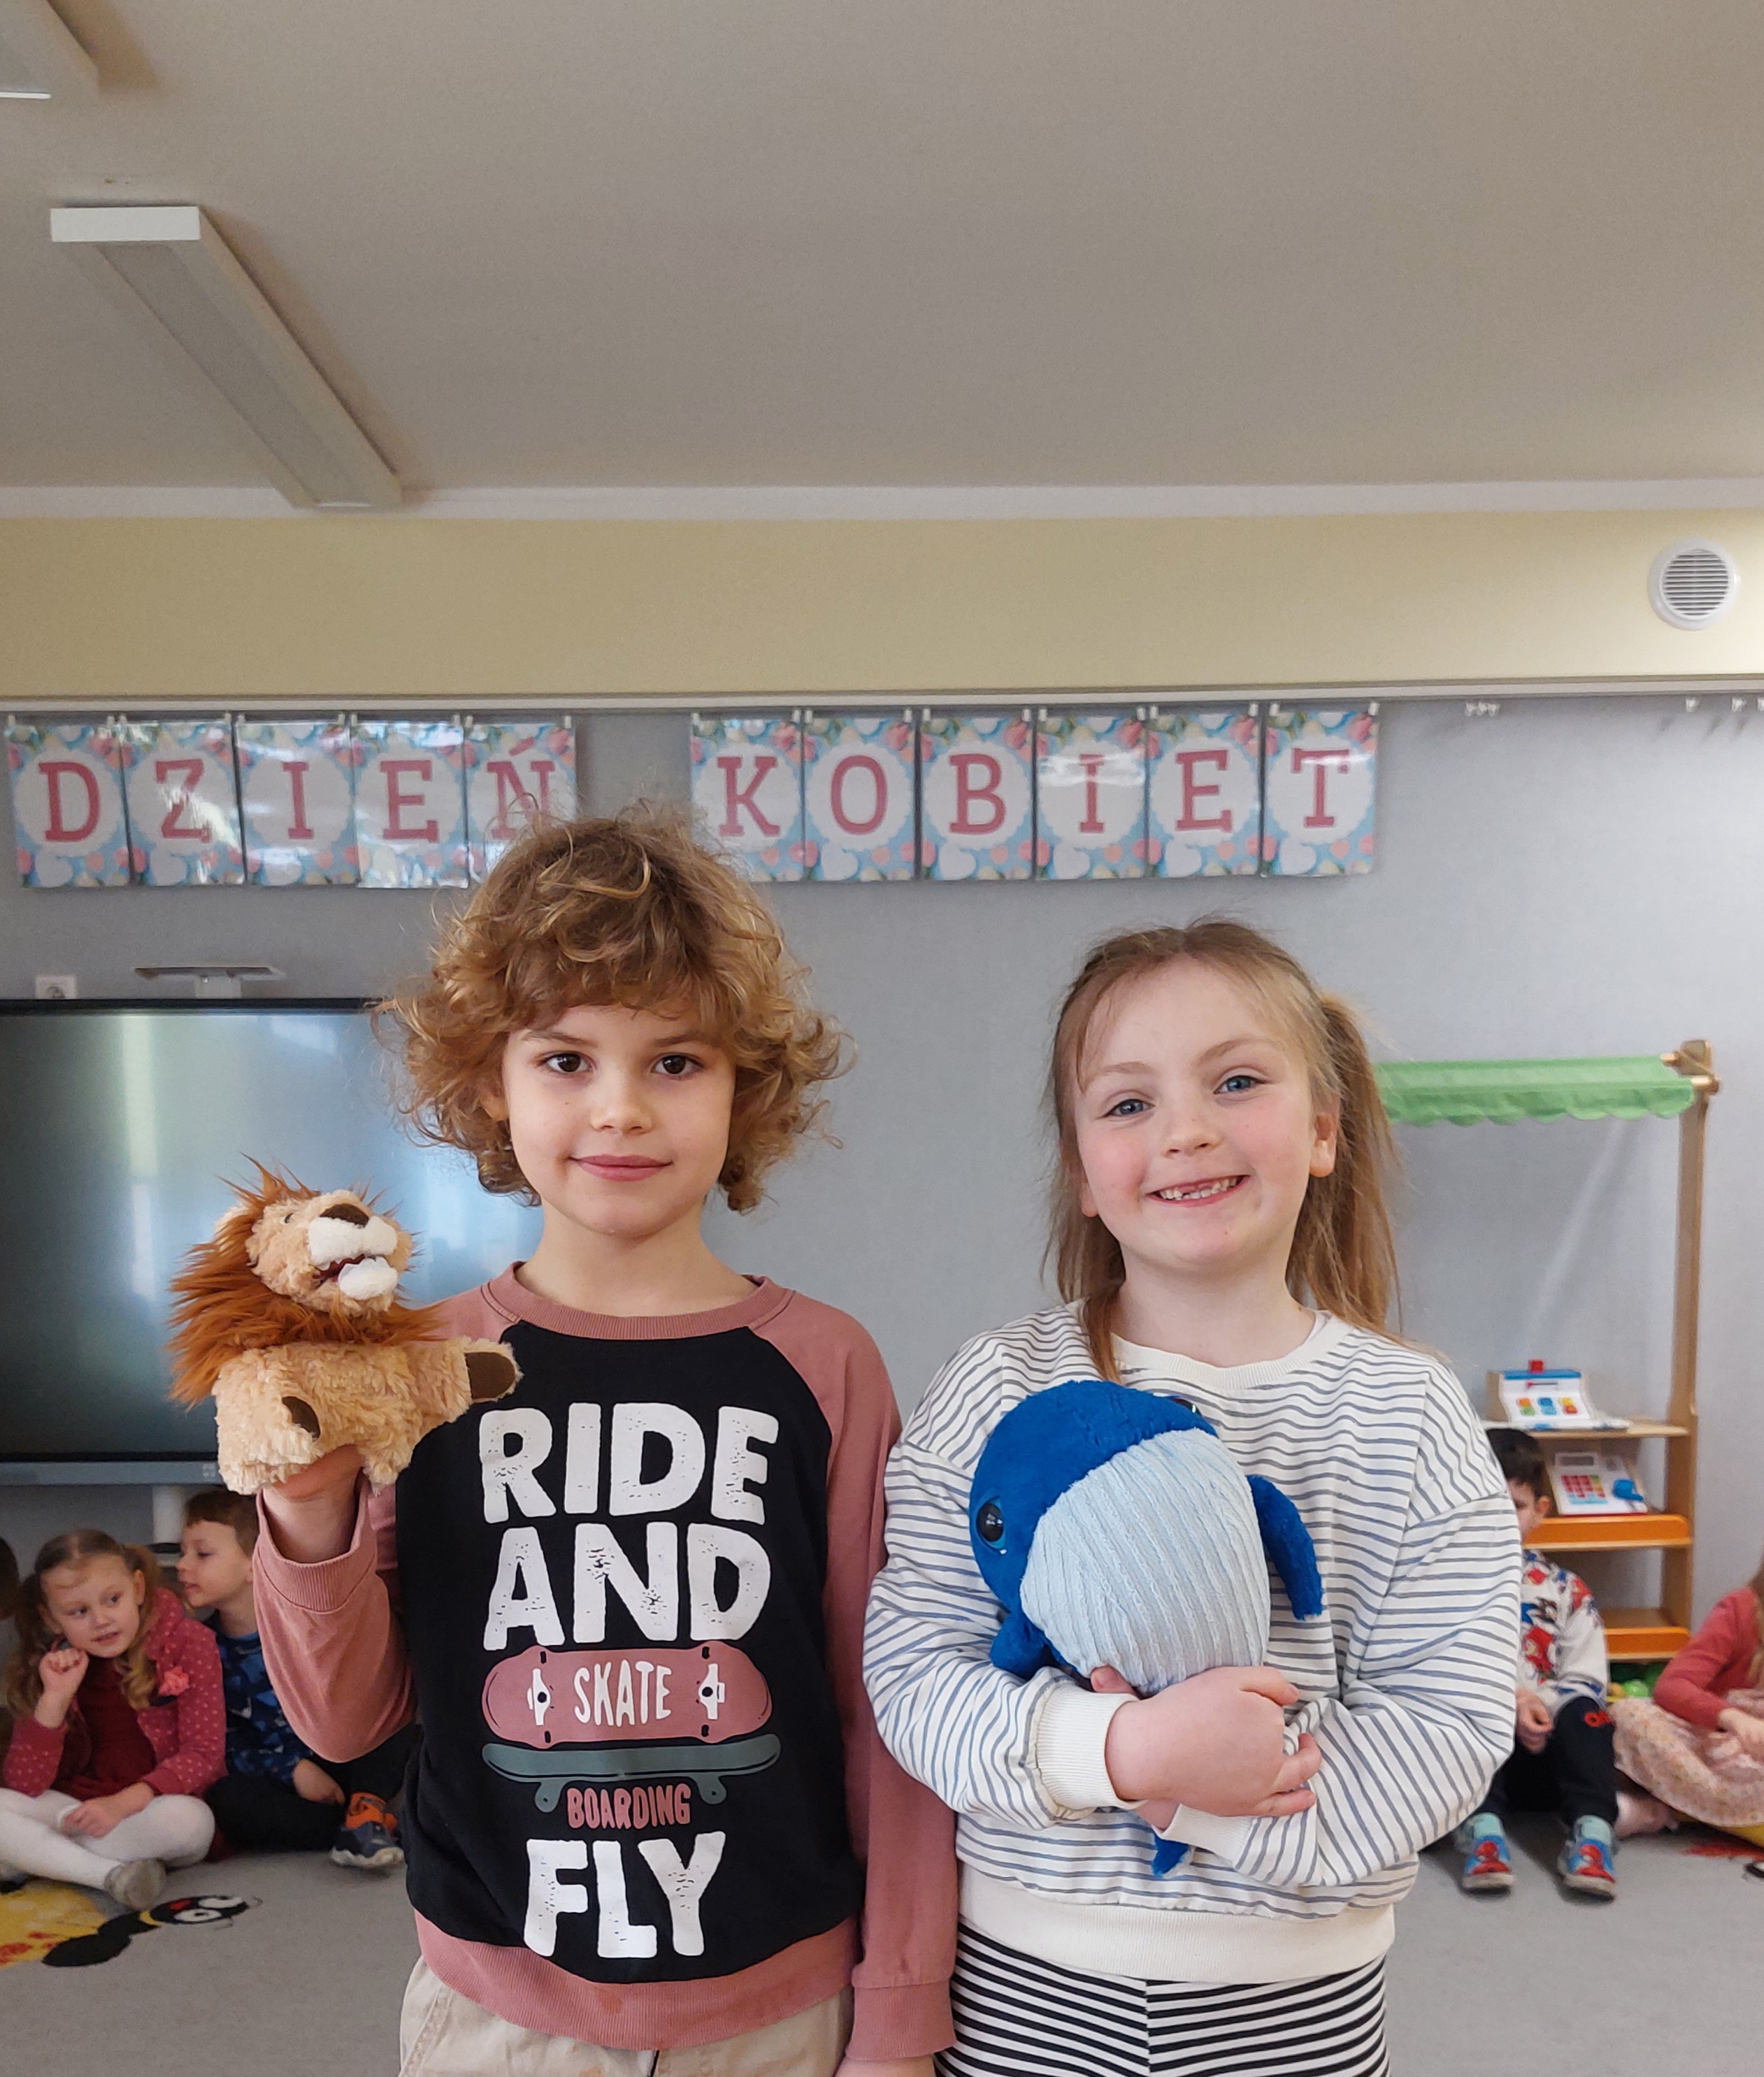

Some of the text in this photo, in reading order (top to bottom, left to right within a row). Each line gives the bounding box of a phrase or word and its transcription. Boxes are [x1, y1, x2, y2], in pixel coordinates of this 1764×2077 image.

[38, 736, 1349, 844] DZIEŃ KOBIET
[478, 1402, 780, 1525] RIDE
[483, 1521, 771, 1651] AND
[573, 1659, 673, 1727] SKATE
[567, 1783, 691, 1830] BOARDING
[523, 1831, 726, 1957] FLY
